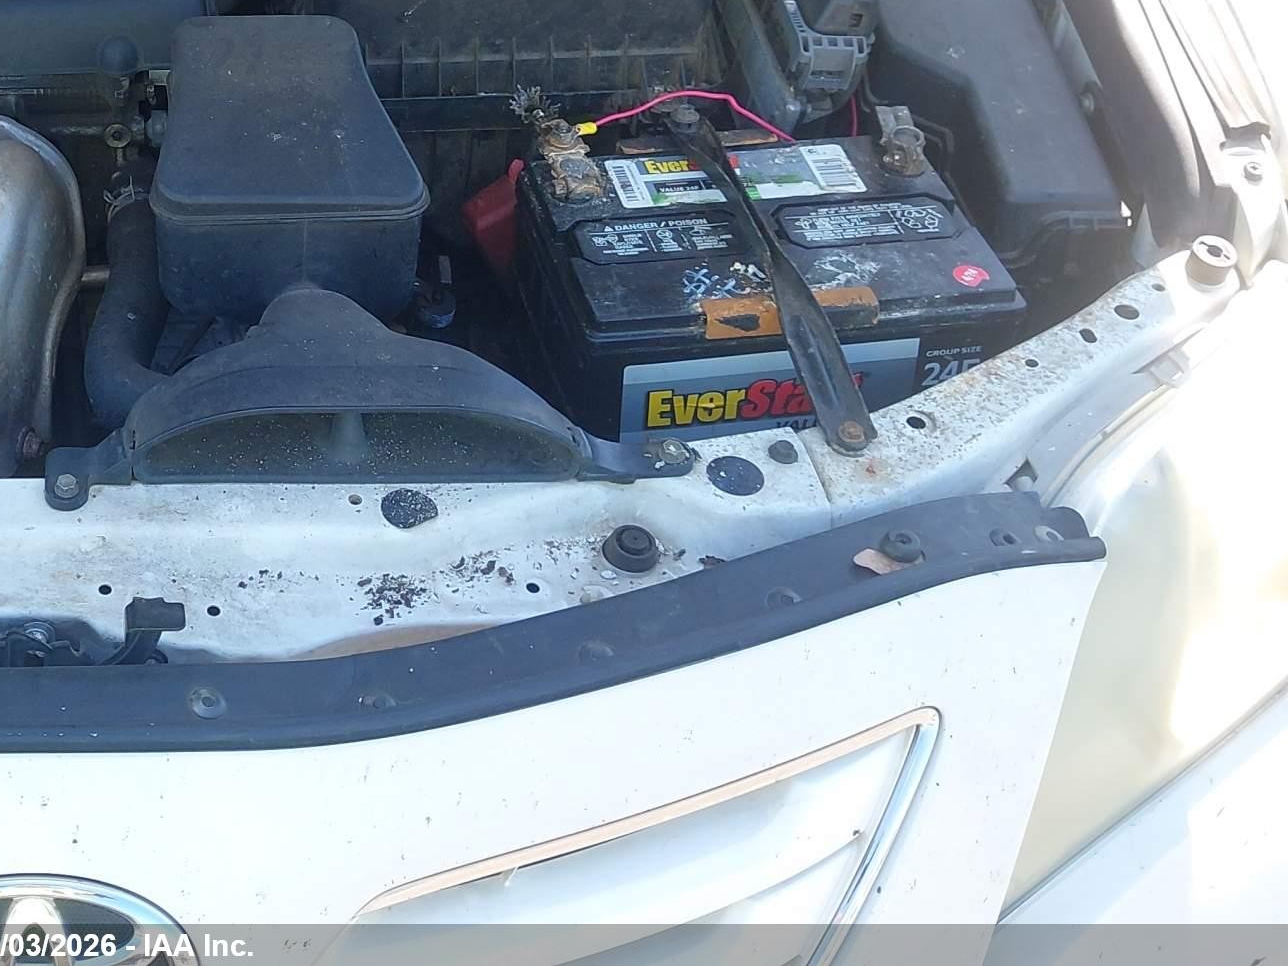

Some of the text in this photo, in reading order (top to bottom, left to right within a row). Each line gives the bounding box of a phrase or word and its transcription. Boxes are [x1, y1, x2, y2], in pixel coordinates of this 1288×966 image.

[615, 222, 658, 232] DANGER
[668, 218, 708, 227] POISON
[926, 345, 983, 357] GROUP SIZE
[647, 372, 864, 429] EverSta
